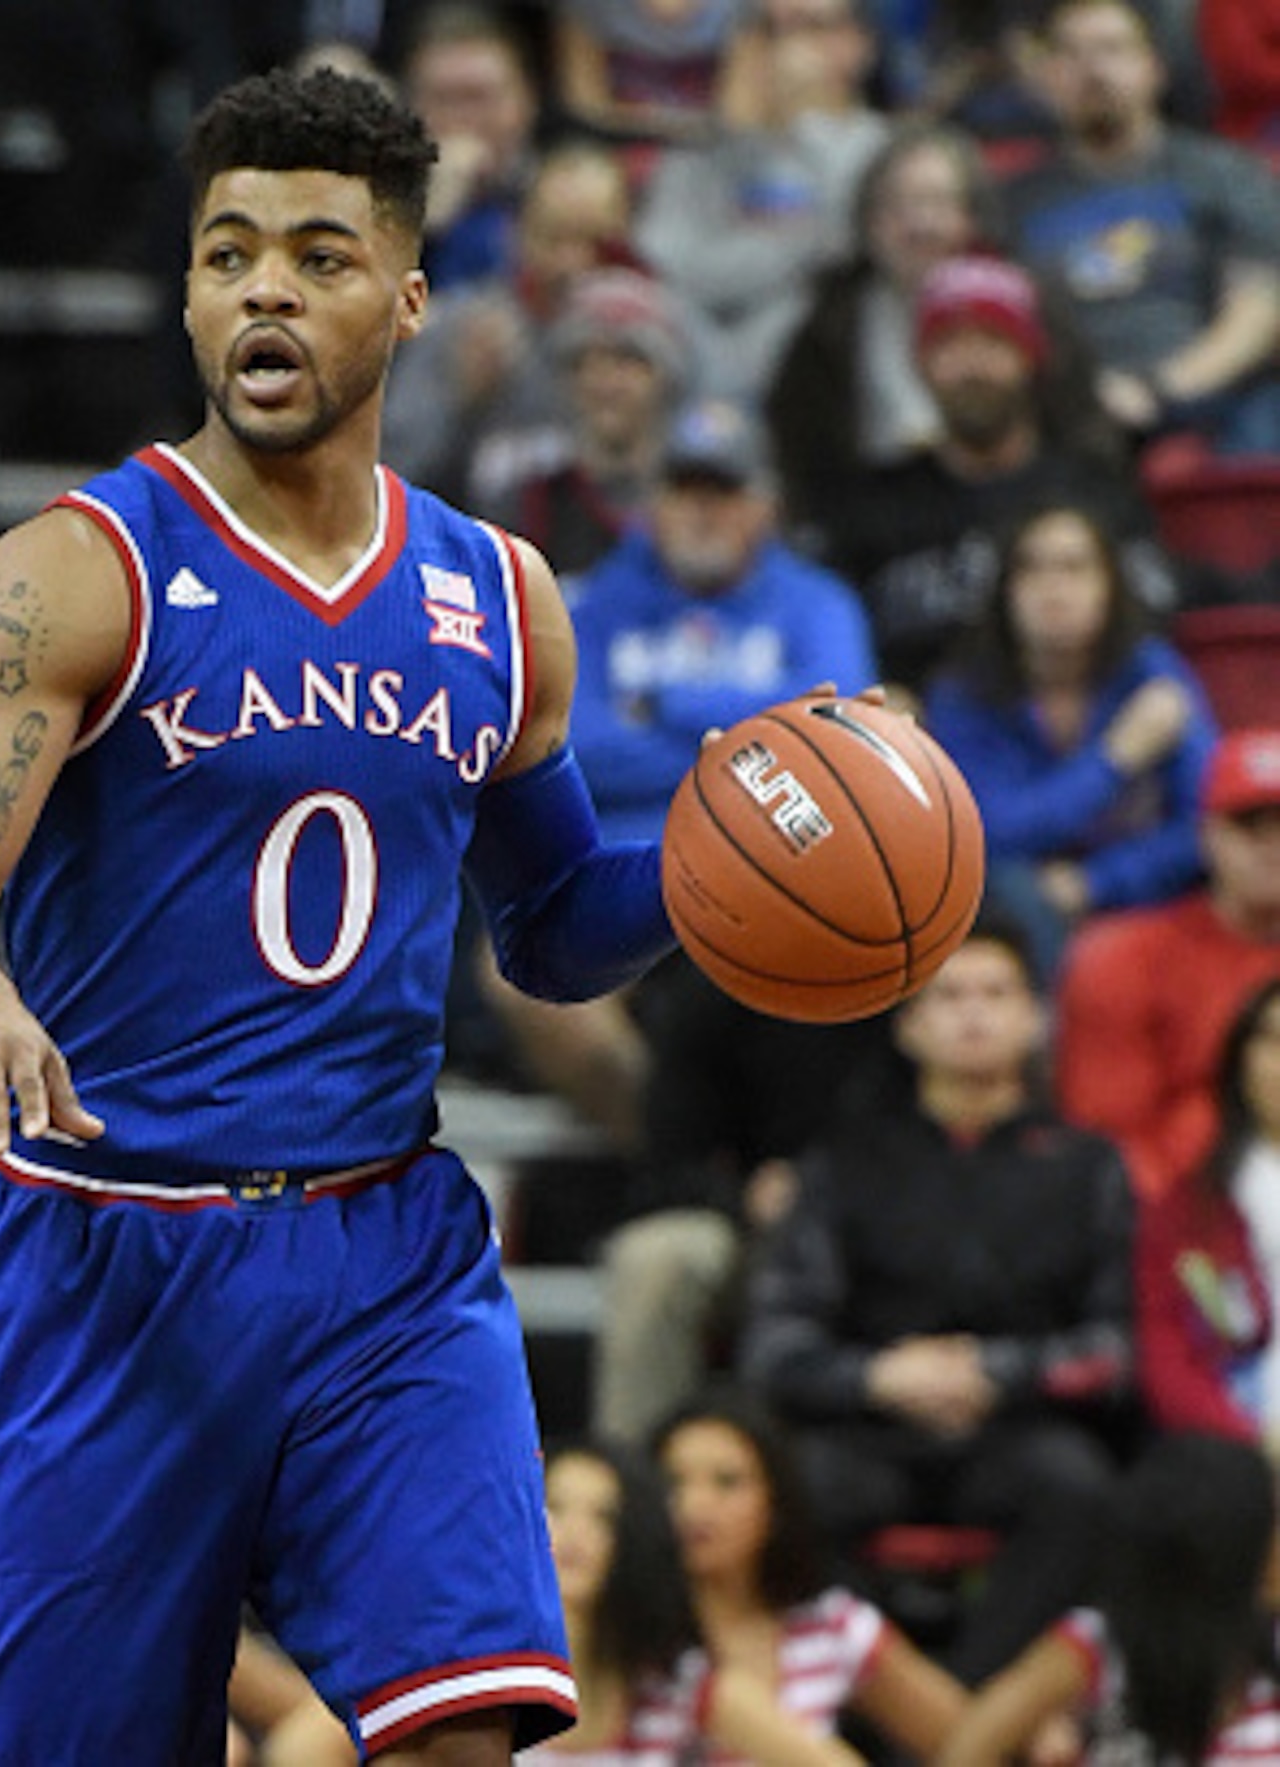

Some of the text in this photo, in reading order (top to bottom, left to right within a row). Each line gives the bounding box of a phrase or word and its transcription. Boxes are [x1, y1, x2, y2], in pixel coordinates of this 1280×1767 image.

[140, 659, 502, 783] KANSAS
[728, 740, 834, 853] ELITE
[250, 788, 380, 989] 0
